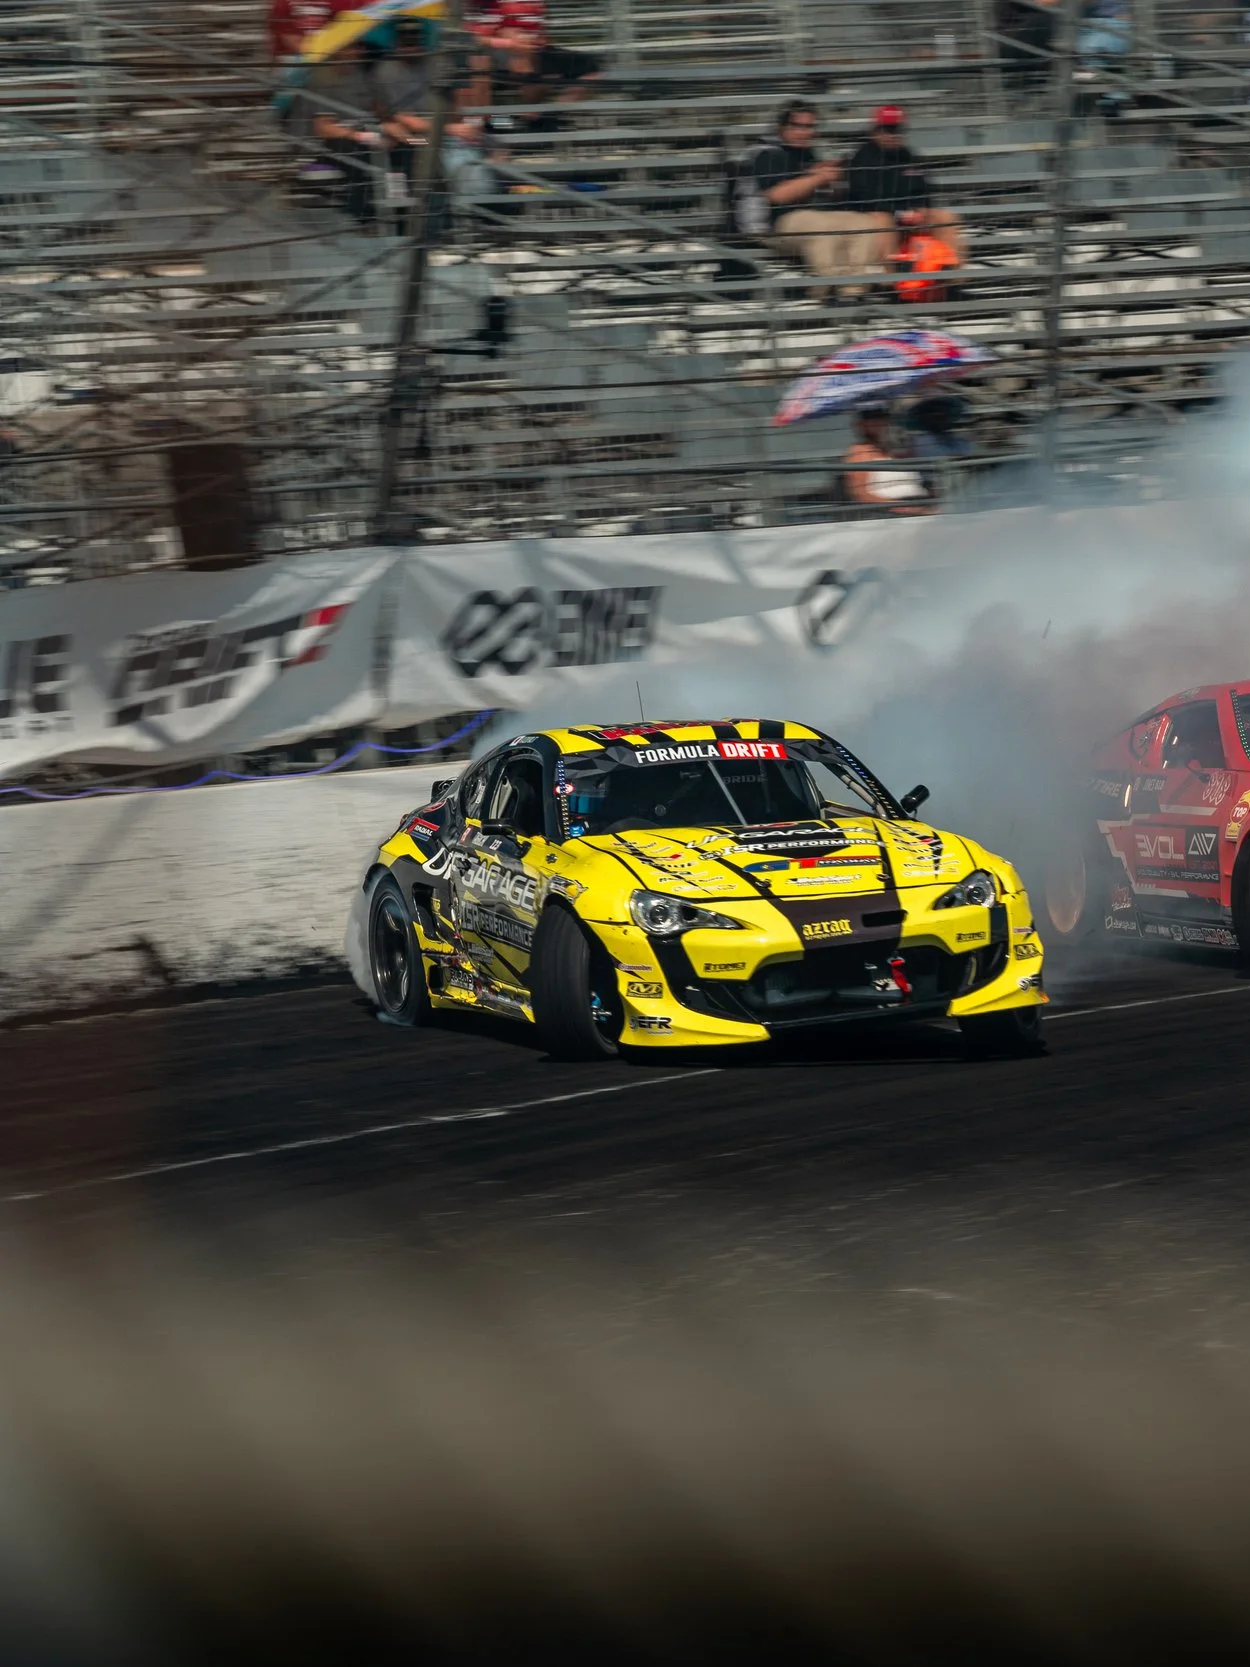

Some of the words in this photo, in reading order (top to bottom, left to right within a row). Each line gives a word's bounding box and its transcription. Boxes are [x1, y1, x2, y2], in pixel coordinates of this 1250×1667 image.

[635, 744, 720, 764] FORMULA
[723, 743, 781, 759] DRIFT
[1232, 806, 1248, 818] TOP
[721, 842, 766, 857] ISR
[767, 838, 887, 850] PERFORMANCE
